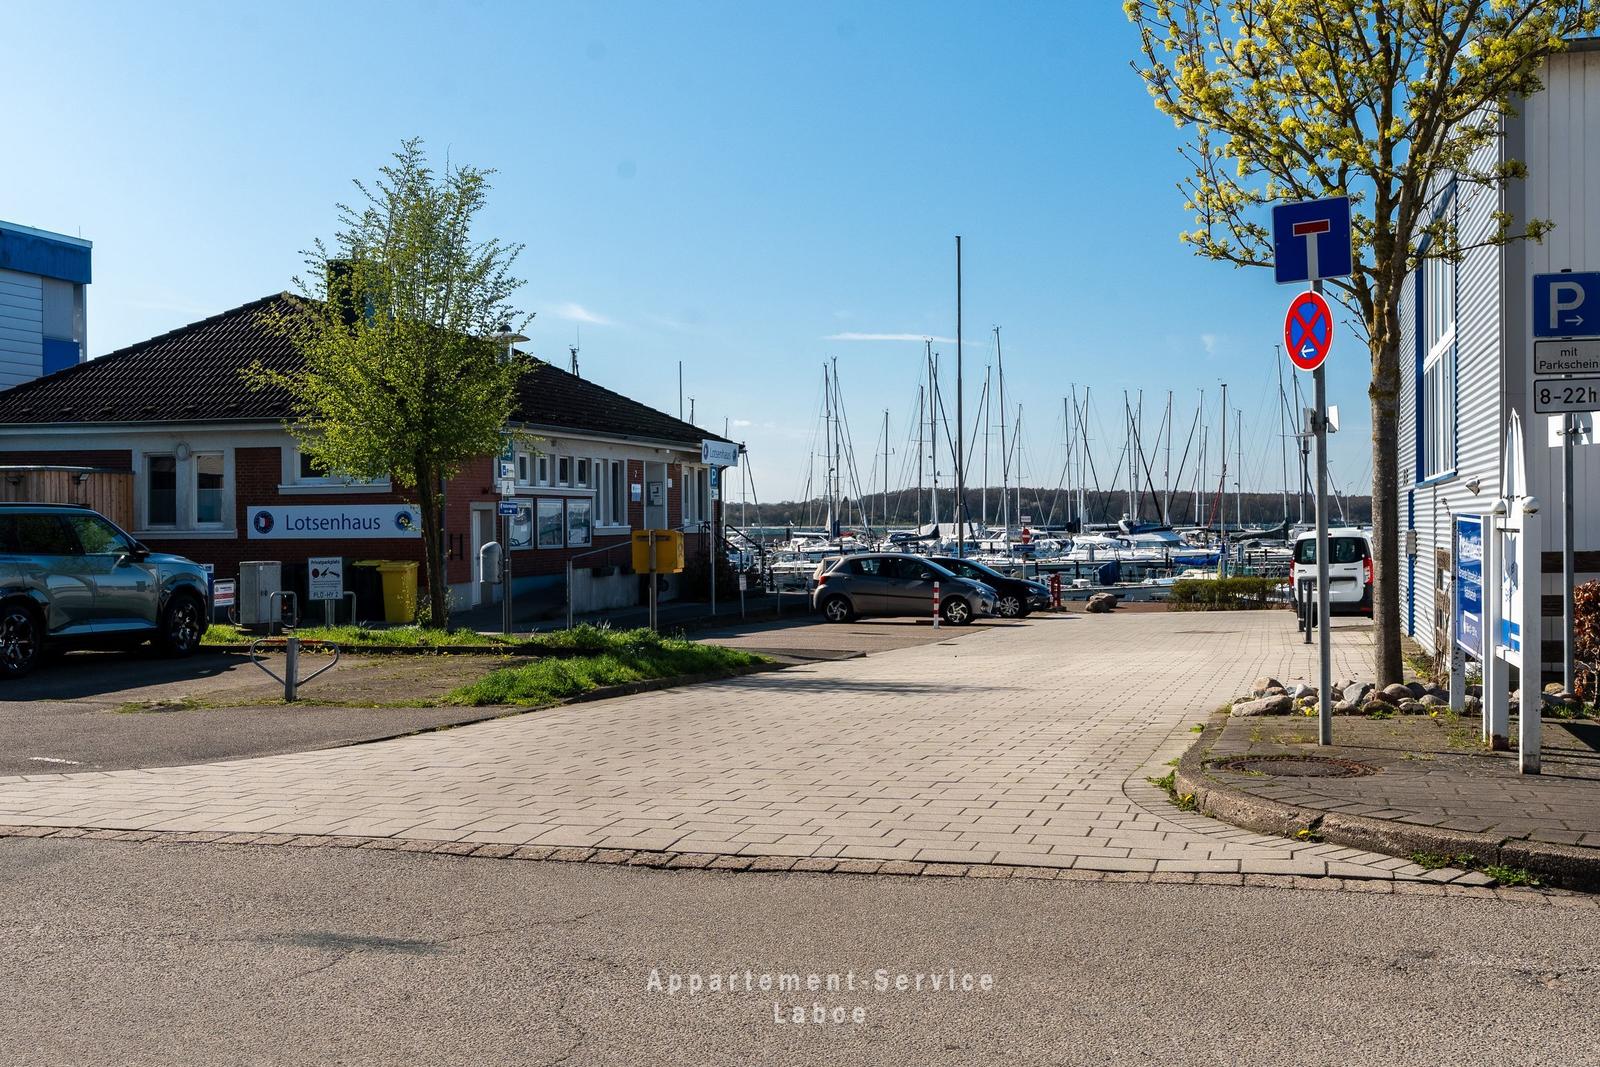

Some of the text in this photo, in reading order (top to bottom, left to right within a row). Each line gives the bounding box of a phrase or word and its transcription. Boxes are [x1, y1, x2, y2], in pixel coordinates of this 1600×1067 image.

[1550, 282, 1585, 328] P
[1560, 347, 1578, 357] mit
[1539, 359, 1598, 370] Parkschein
[711, 468, 717, 485] P
[285, 513, 381, 531] Lotsenhaus
